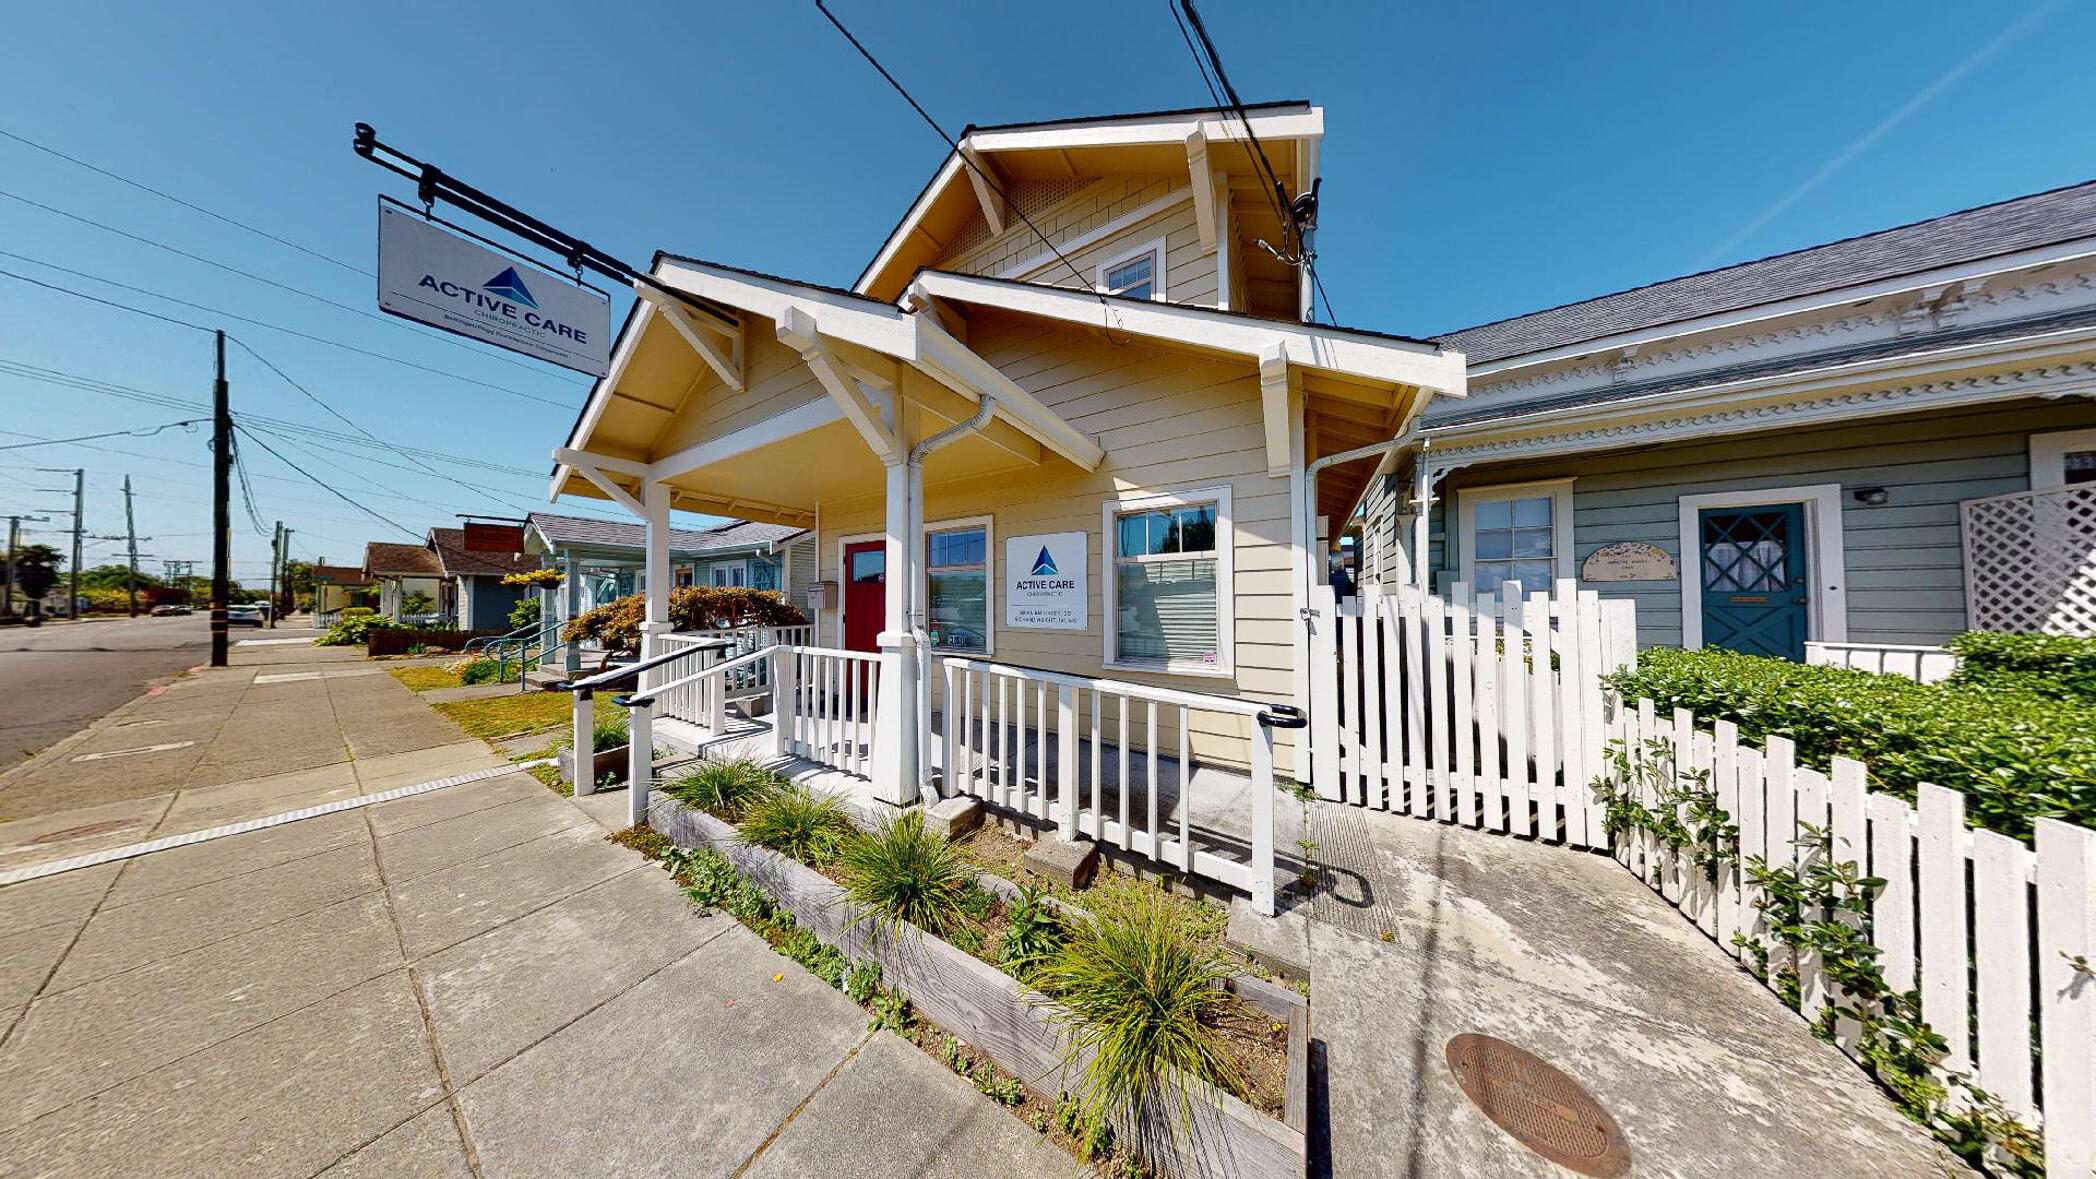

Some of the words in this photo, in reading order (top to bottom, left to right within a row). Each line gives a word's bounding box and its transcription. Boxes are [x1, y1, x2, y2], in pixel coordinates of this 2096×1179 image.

[418, 274, 517, 320] ACTIVE
[524, 309, 588, 345] CARE
[474, 309, 547, 339] CHIROPRACTIC
[1016, 580, 1047, 590] ACTIVE
[1048, 580, 1075, 589] CARE
